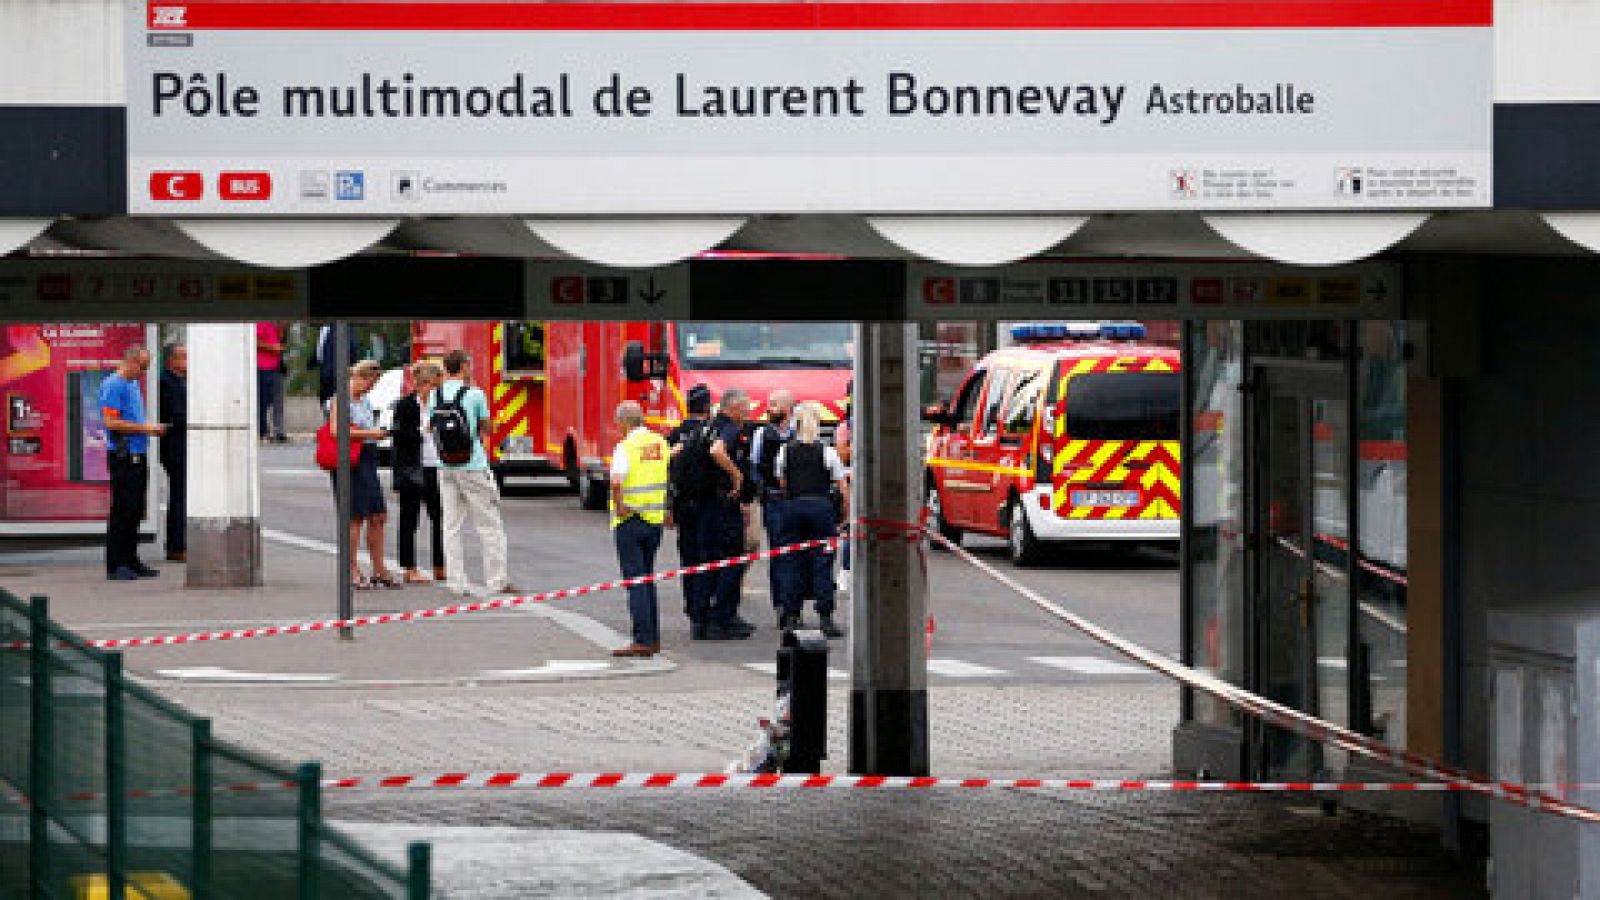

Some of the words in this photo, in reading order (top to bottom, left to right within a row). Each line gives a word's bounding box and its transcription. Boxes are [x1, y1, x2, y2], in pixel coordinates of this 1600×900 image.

[152, 71, 259, 118] Pôle
[282, 72, 571, 118] multimodal
[592, 72, 651, 118] de
[675, 73, 863, 118] Laurent
[886, 72, 1126, 126] Bonnevay
[1145, 83, 1315, 115] Astroballe
[168, 176, 186, 198] C
[229, 179, 261, 194] BUS
[930, 280, 950, 302] C
